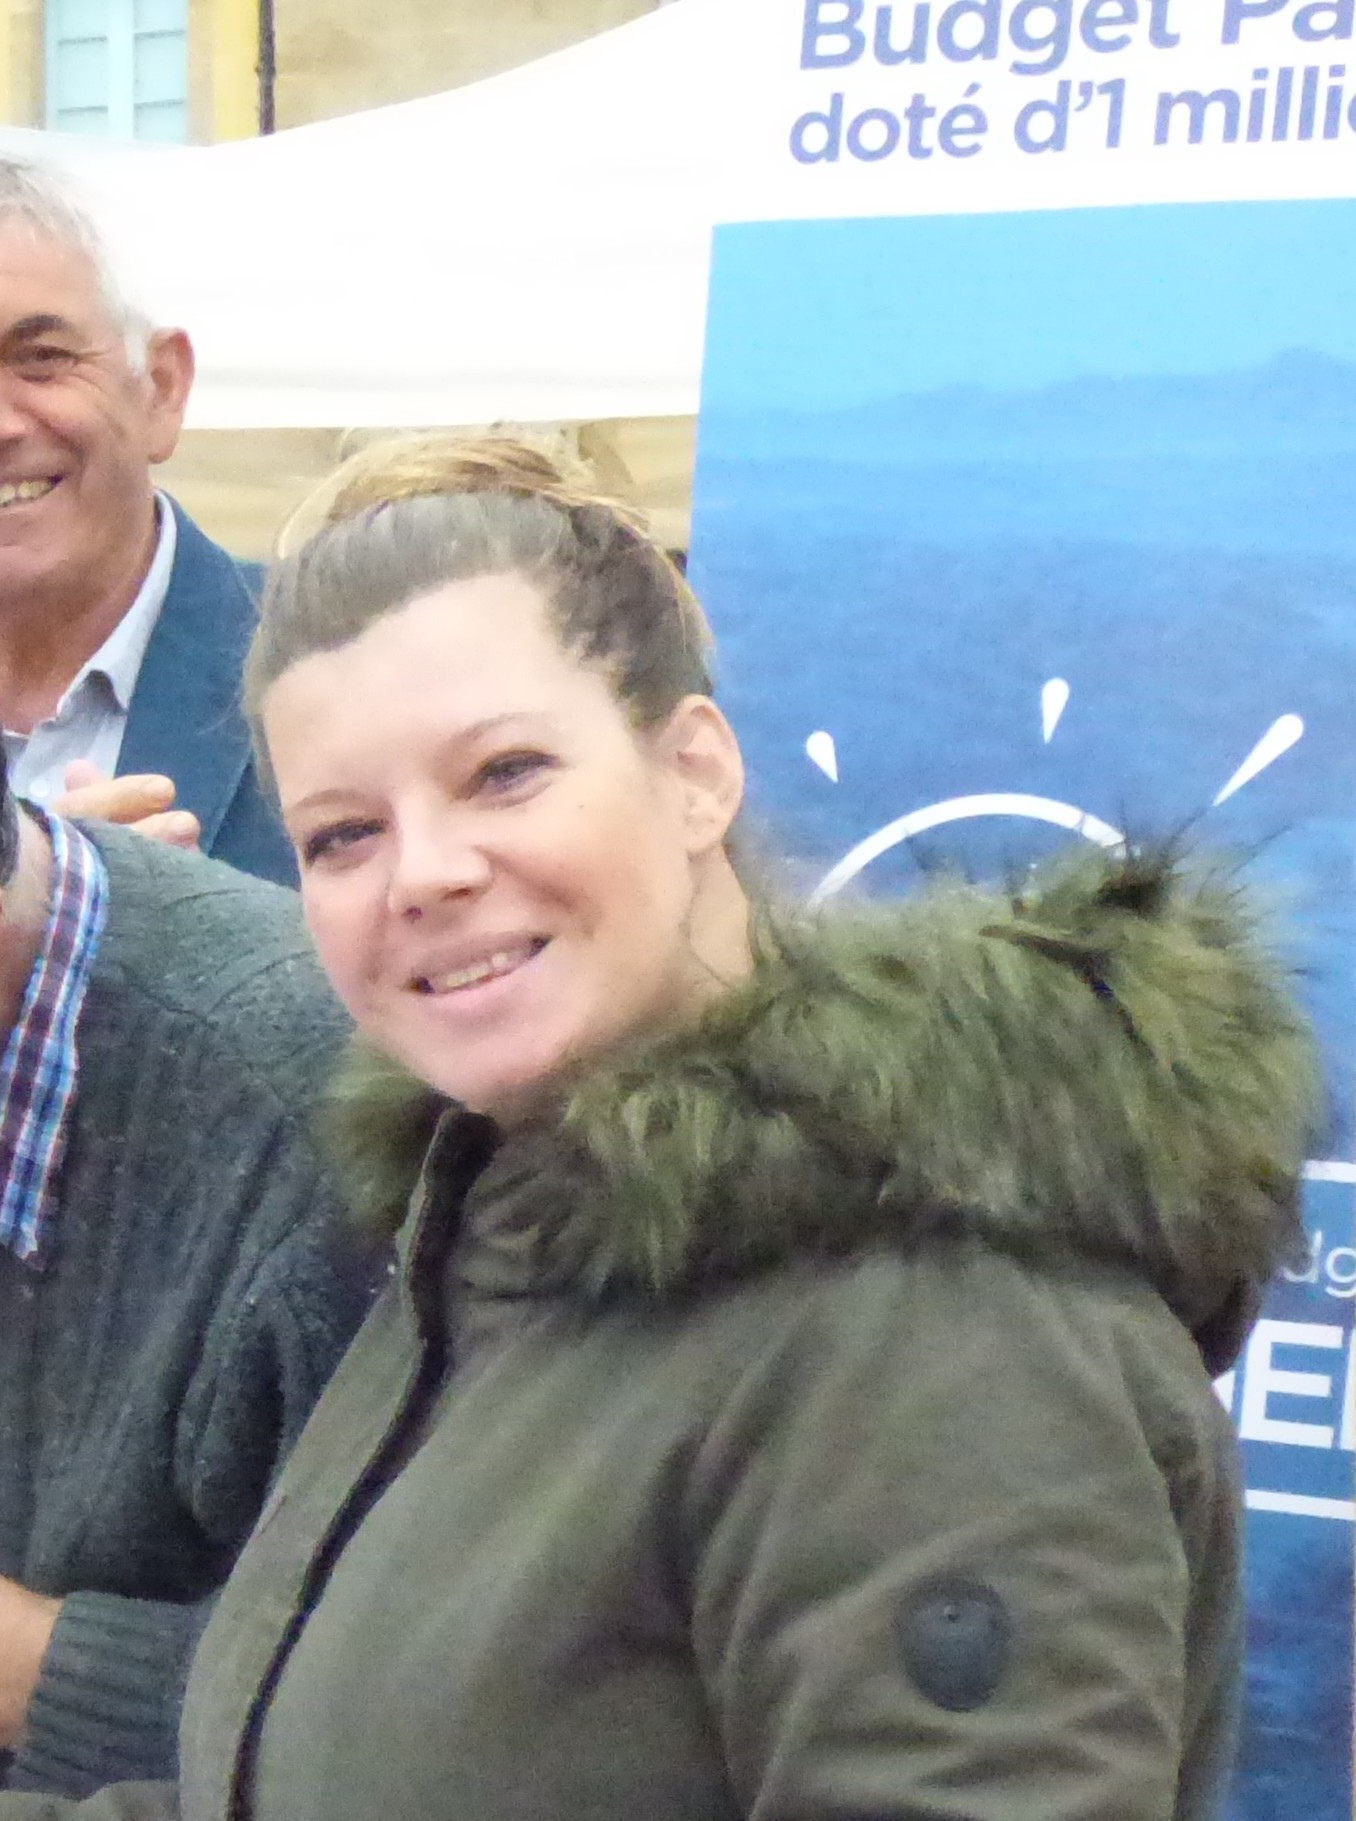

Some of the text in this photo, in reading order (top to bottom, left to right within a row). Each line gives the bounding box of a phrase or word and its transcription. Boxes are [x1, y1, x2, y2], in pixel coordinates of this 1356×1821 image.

[799, 0, 1180, 76] Budget
[789, 64, 1356, 165] doté d'1 milli
